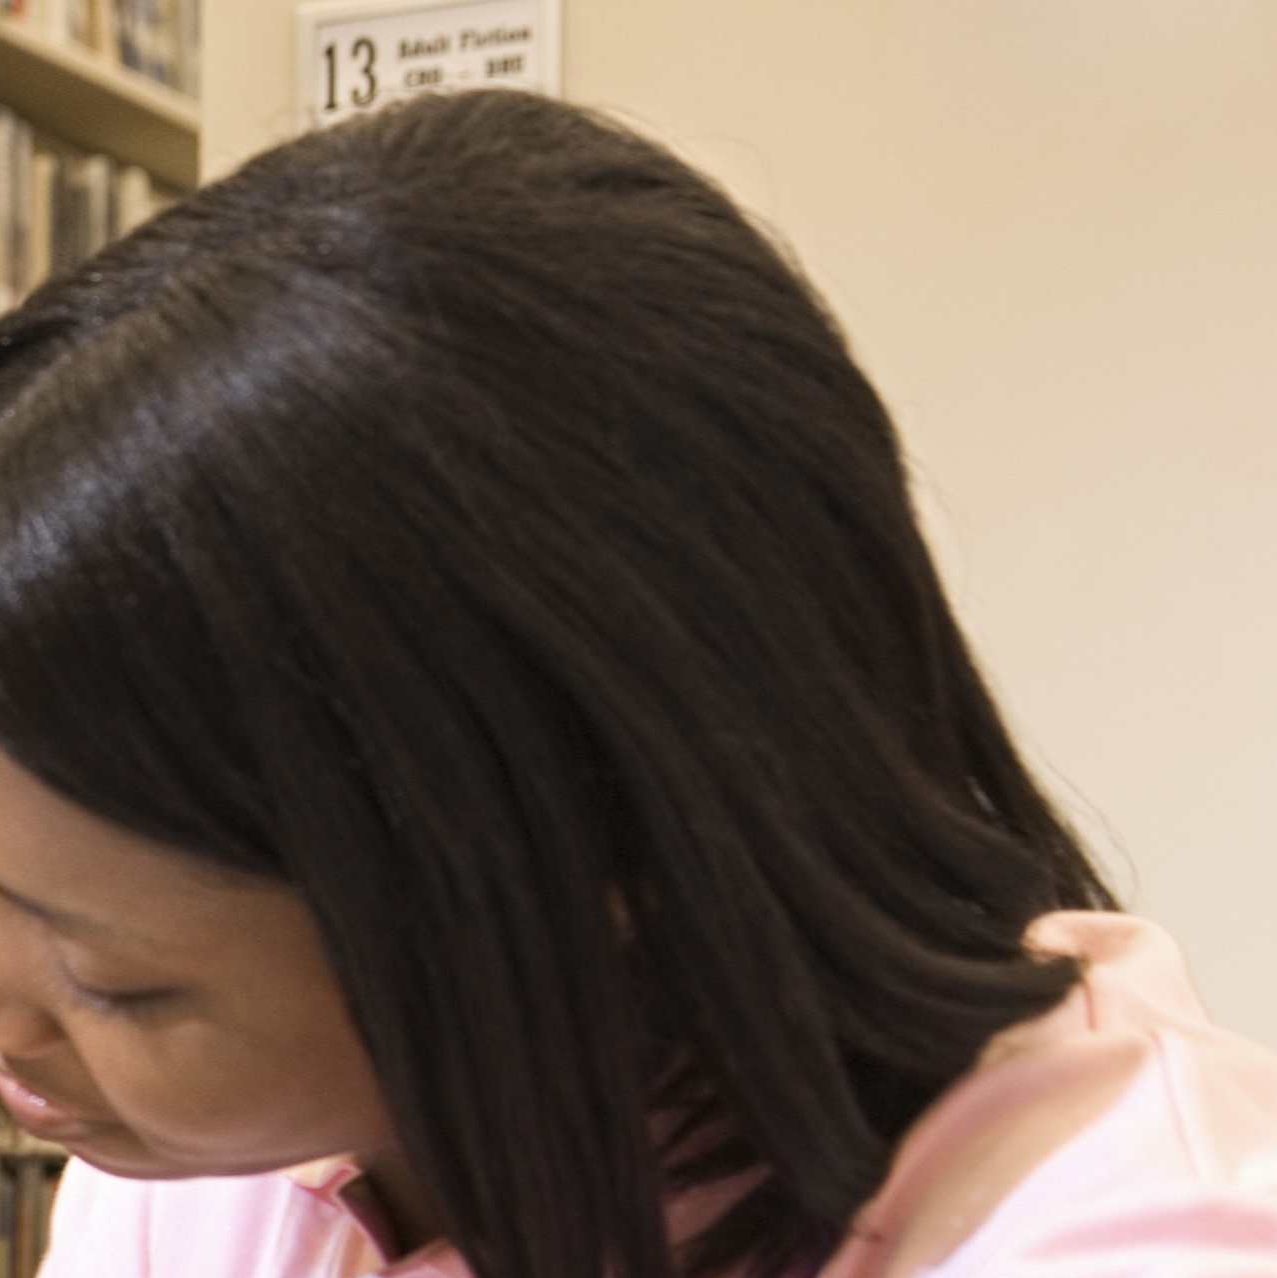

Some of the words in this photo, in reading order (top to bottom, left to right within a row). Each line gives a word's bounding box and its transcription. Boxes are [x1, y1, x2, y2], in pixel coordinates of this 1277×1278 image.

[398, 35, 449, 60] Adult
[459, 25, 530, 50] Fiction
[323, 37, 378, 110] 13
